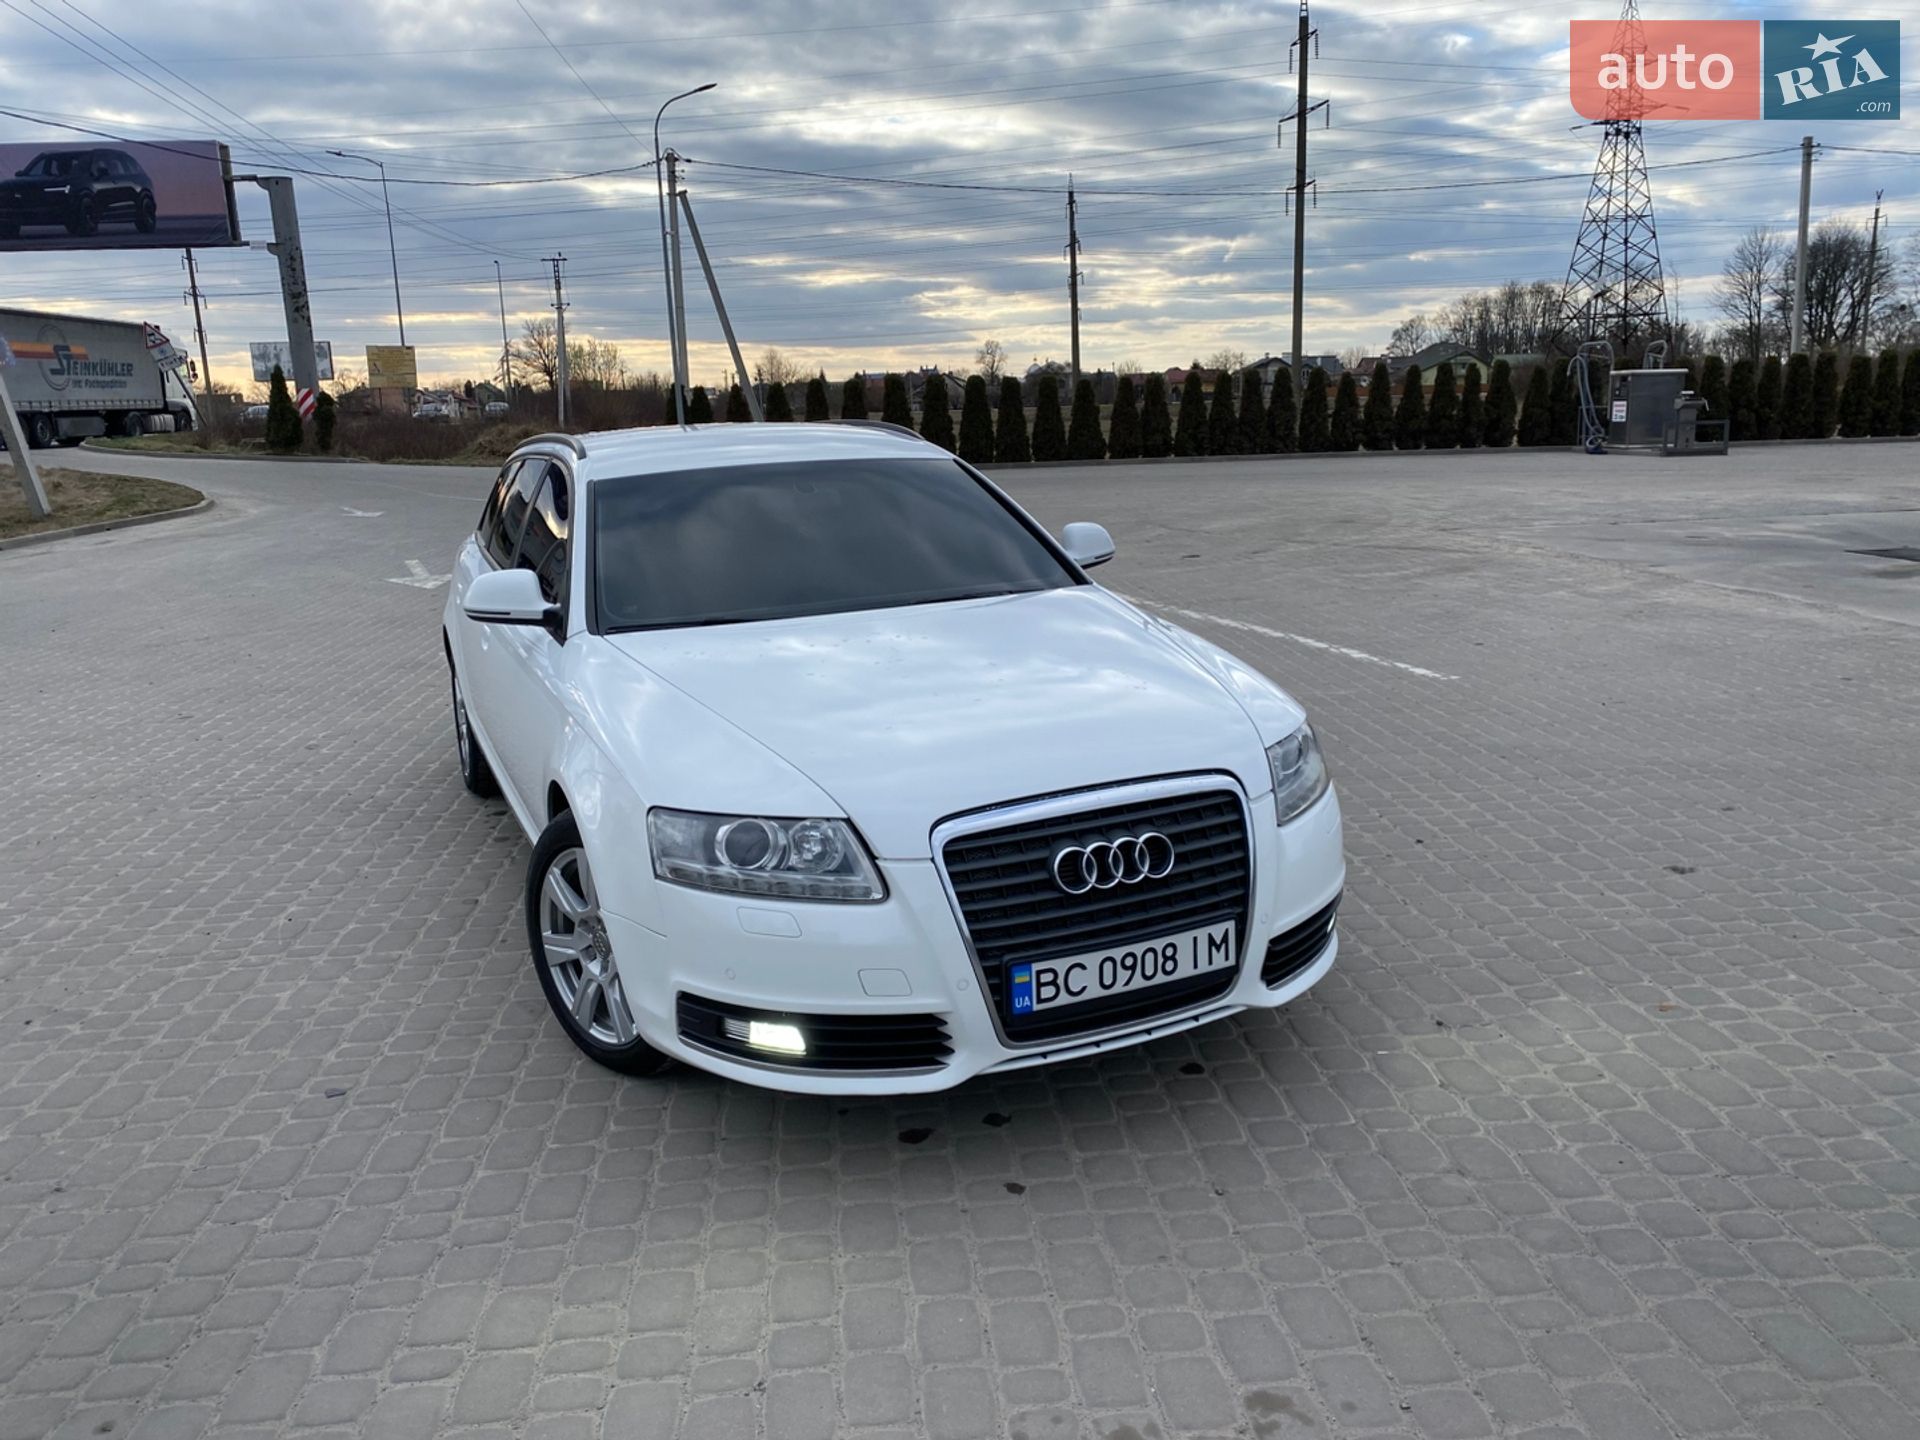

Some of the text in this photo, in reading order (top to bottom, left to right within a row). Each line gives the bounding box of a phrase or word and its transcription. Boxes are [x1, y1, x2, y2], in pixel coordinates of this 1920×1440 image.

[1036, 928, 1230, 1004] BC 0908 IM
[1015, 996, 1031, 1008] UA
